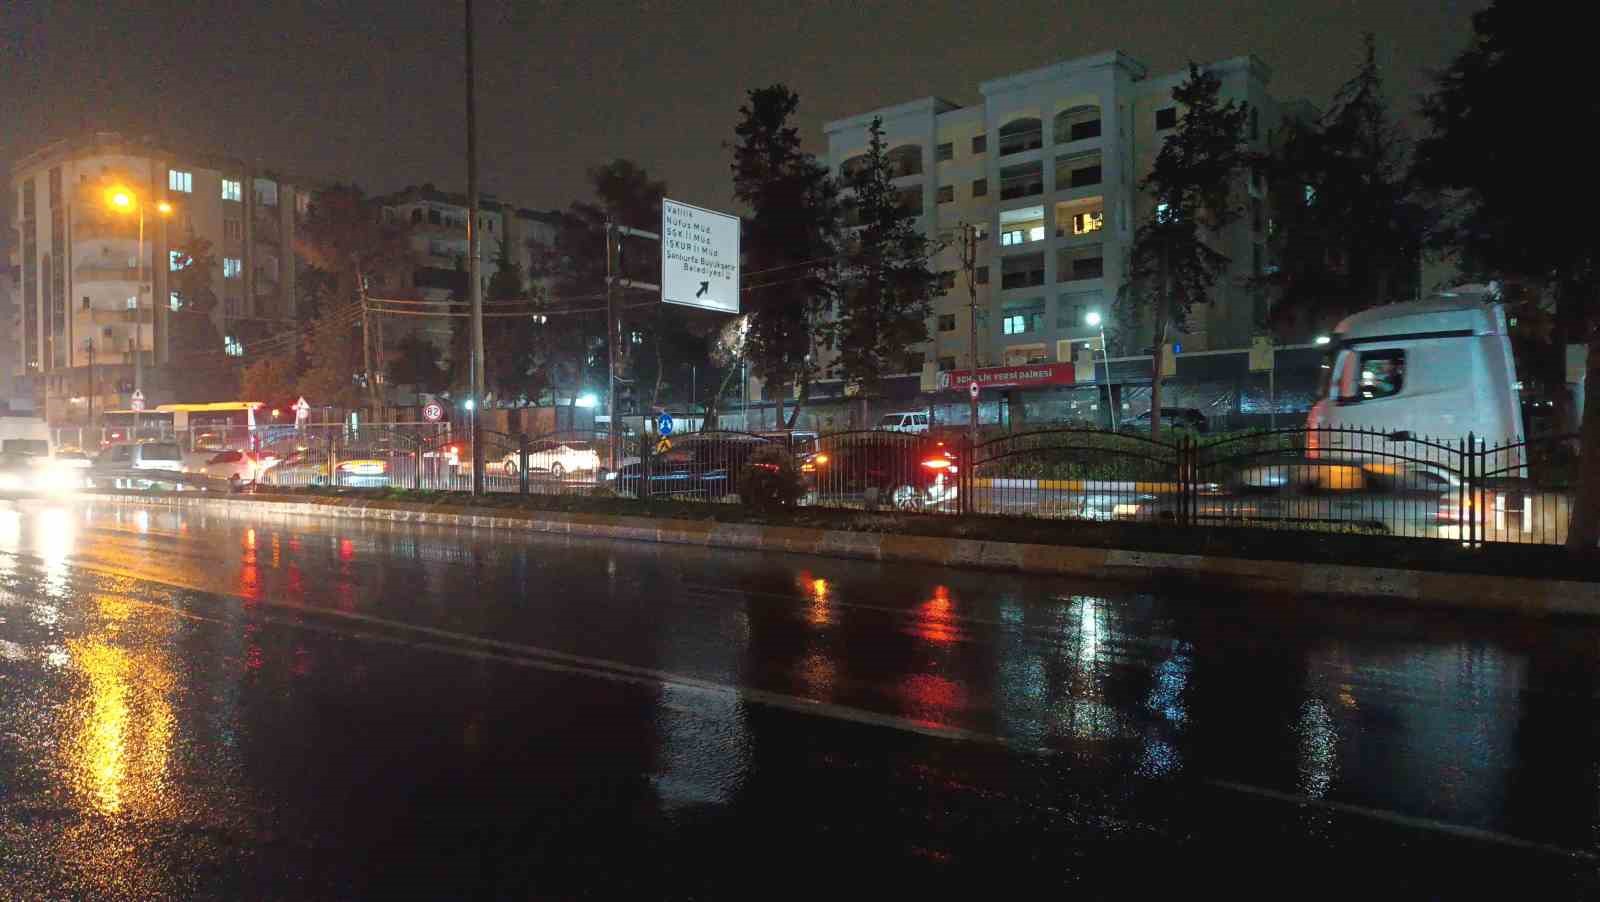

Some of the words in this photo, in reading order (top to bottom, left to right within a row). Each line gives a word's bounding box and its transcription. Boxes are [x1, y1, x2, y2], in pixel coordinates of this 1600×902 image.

[667, 205, 693, 217] Valilik
[667, 216, 691, 229] Nüfus
[428, 407, 438, 416] 82
